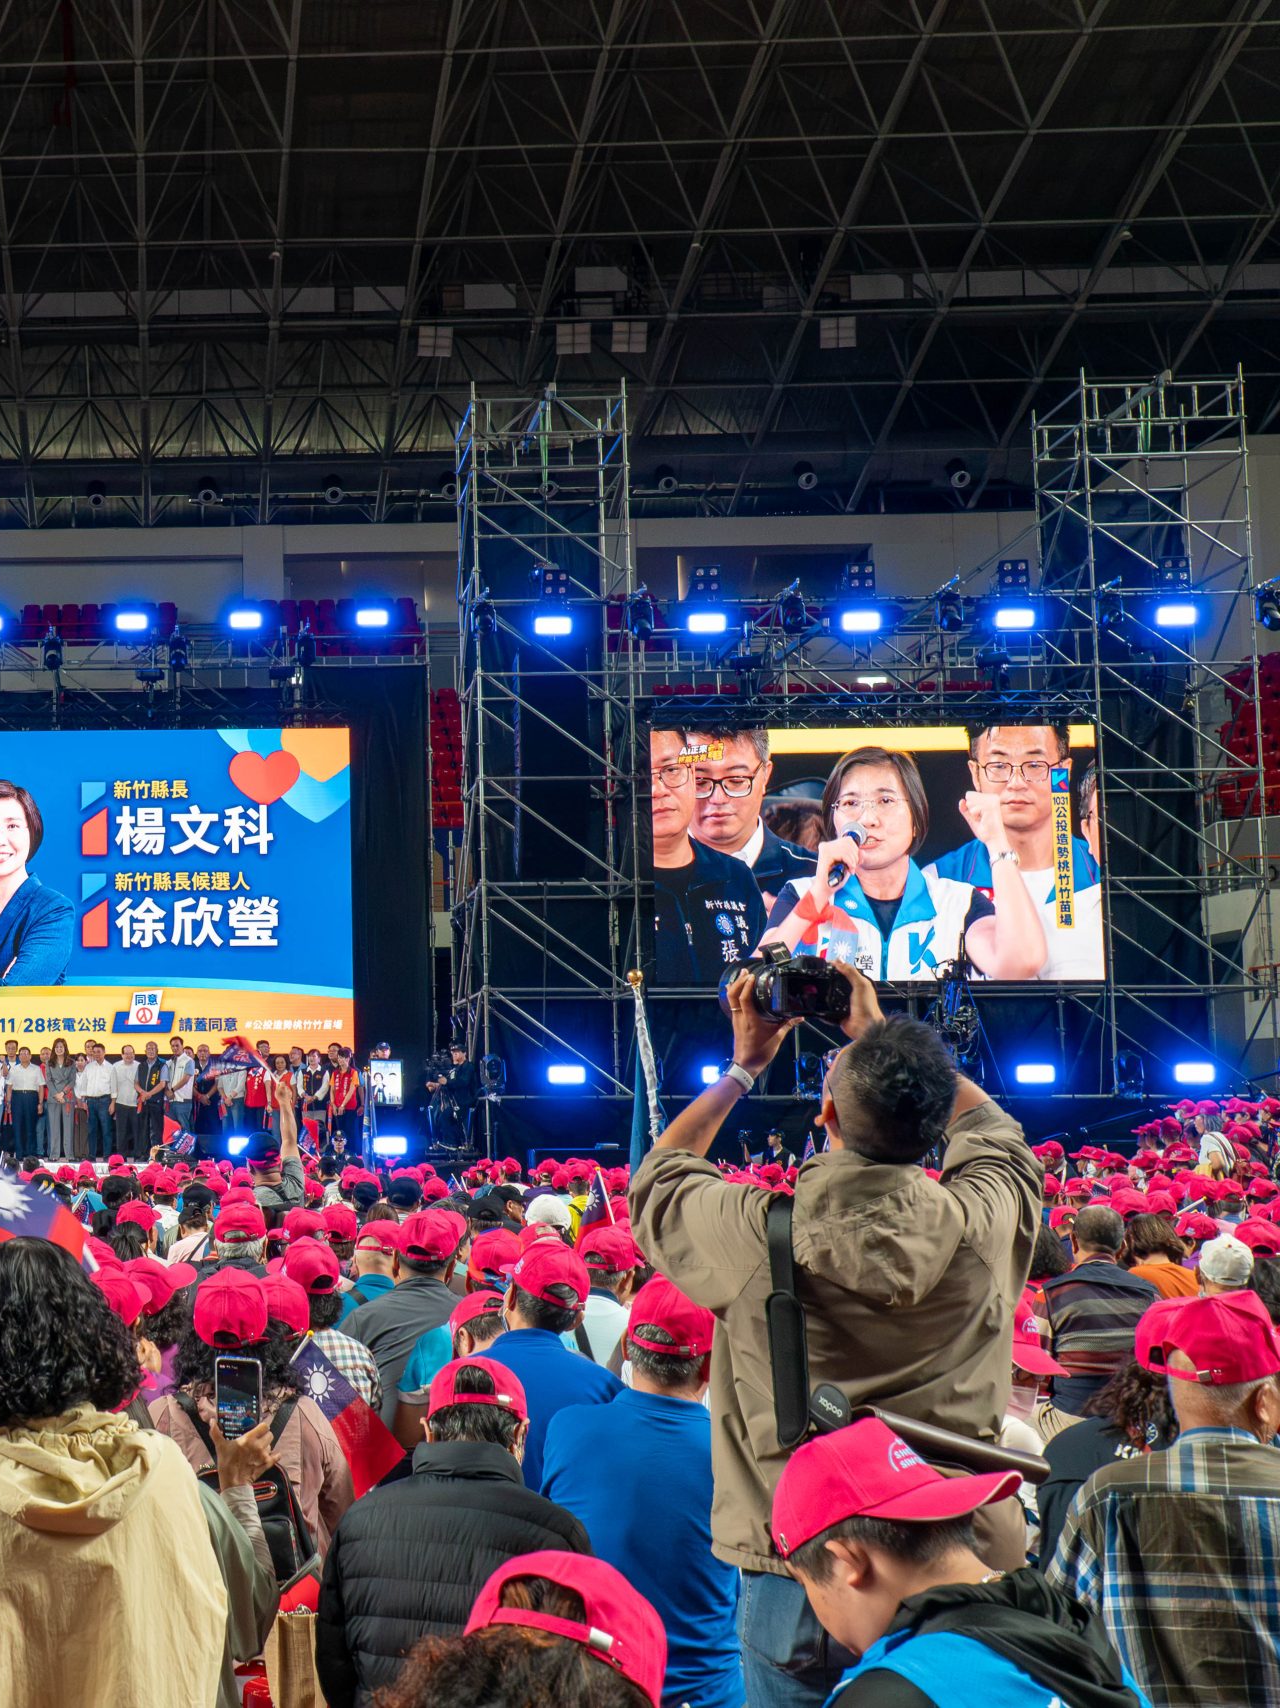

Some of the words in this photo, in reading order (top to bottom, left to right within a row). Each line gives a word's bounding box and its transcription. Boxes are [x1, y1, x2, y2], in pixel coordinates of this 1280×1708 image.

[113, 780, 189, 799] 新竹縣長
[115, 804, 274, 856] 楊文科
[114, 871, 251, 892] 新竹縣長候選人
[115, 896, 279, 948] 徐欣瑩
[134, 993, 159, 1006] 同意
[178, 1017, 238, 1032] 請蓋同意
[819, 1396, 843, 1418] Godox
